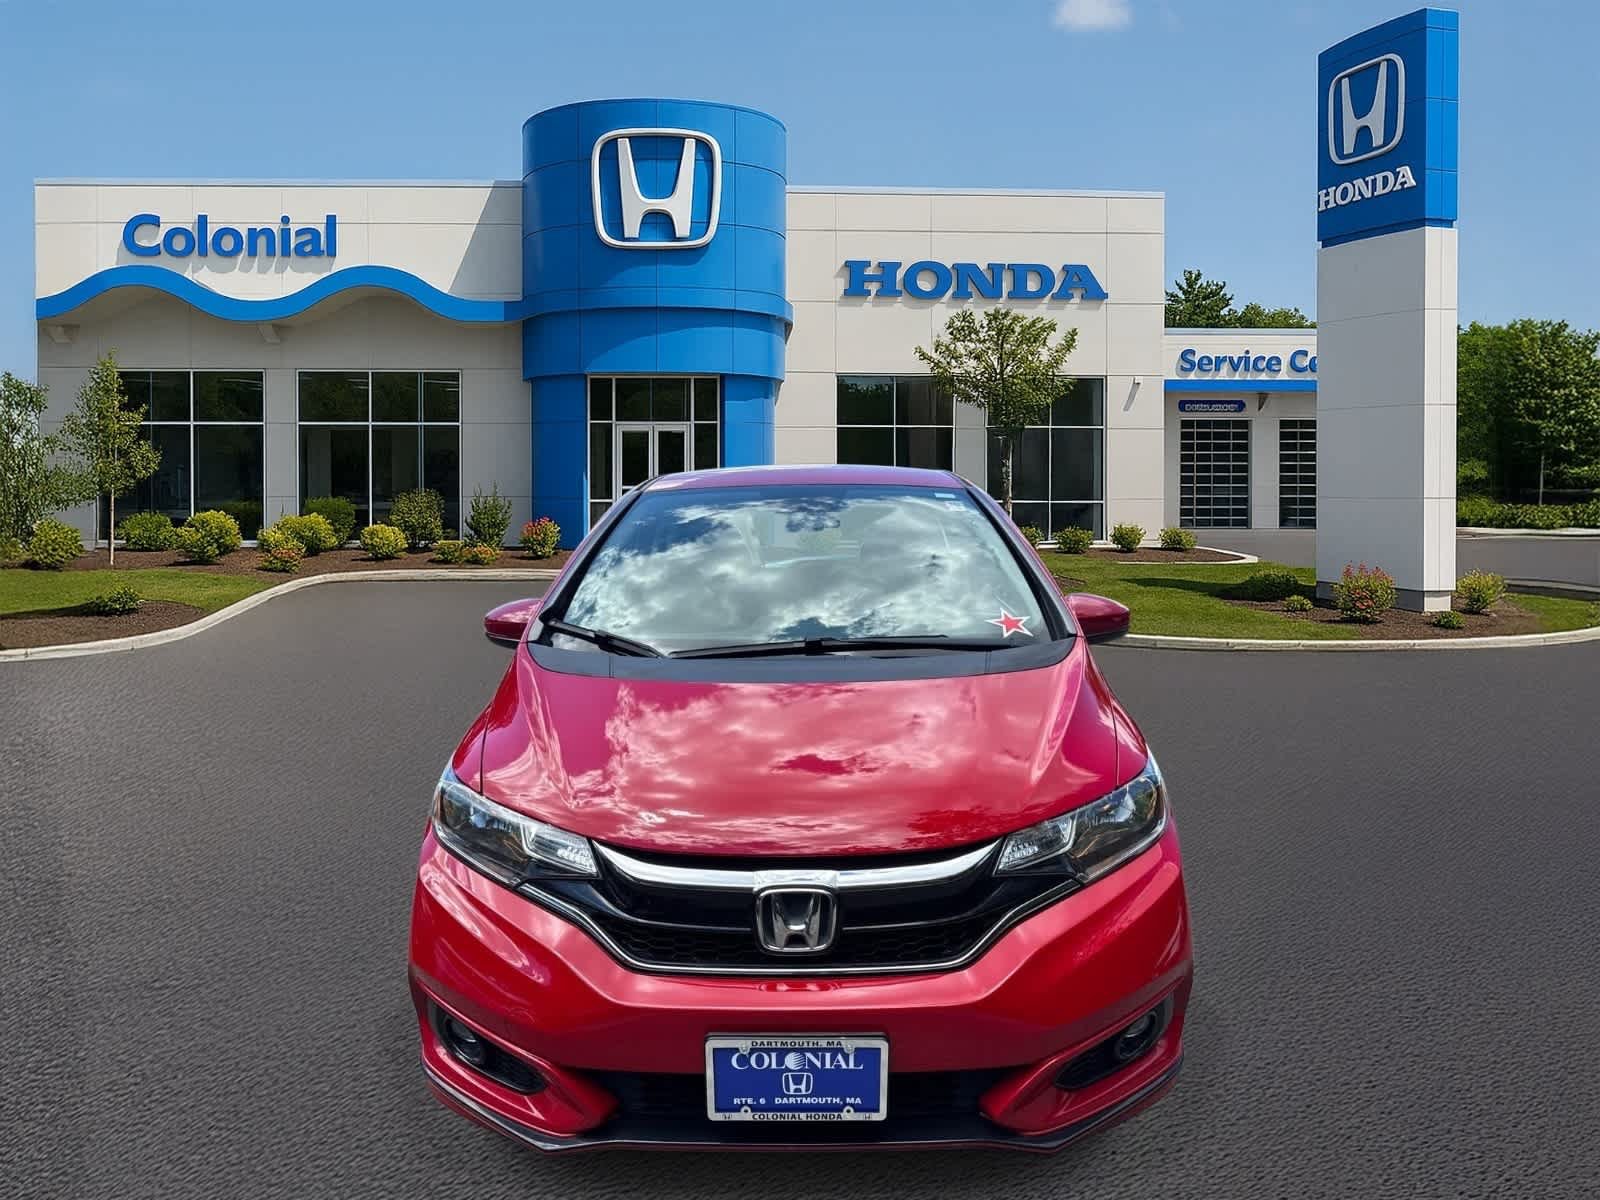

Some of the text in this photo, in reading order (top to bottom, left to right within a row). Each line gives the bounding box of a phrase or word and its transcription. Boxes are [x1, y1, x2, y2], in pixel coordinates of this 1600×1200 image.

[1318, 165, 1417, 211] HONDA
[122, 213, 337, 257] Colonial
[843, 259, 1108, 300] HONDA
[1179, 348, 1282, 373] Service
[826, 1040, 842, 1048] MA
[731, 1051, 864, 1070] COLONIAL
[733, 1096, 862, 1105] RTE. 6 DARTMOUTH, MA
[752, 1113, 843, 1121] COLONIAL HONDA
